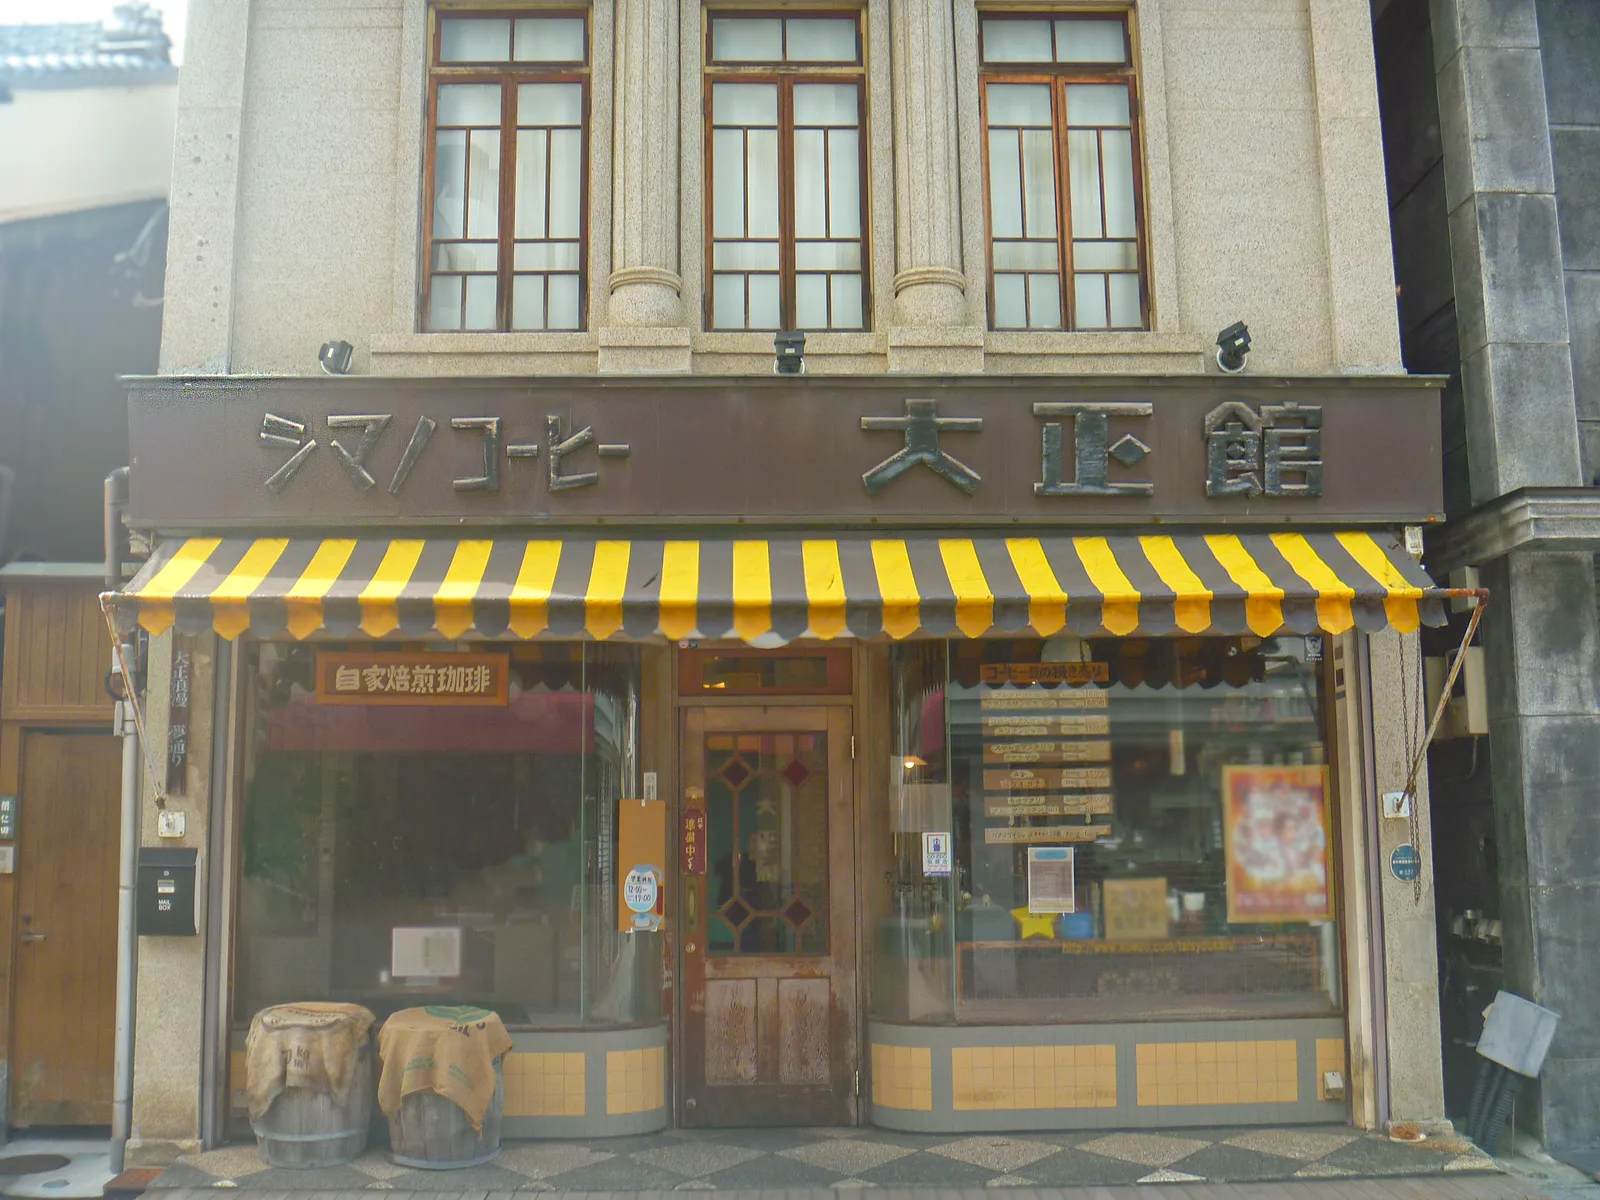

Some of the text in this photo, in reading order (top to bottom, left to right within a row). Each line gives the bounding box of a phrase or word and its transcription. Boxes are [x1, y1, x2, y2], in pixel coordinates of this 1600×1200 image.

[258, 412, 631, 493] シマノコーヒー
[860, 398, 1324, 498] 大正館
[334, 664, 491, 695] 自家焙煎珈琲
